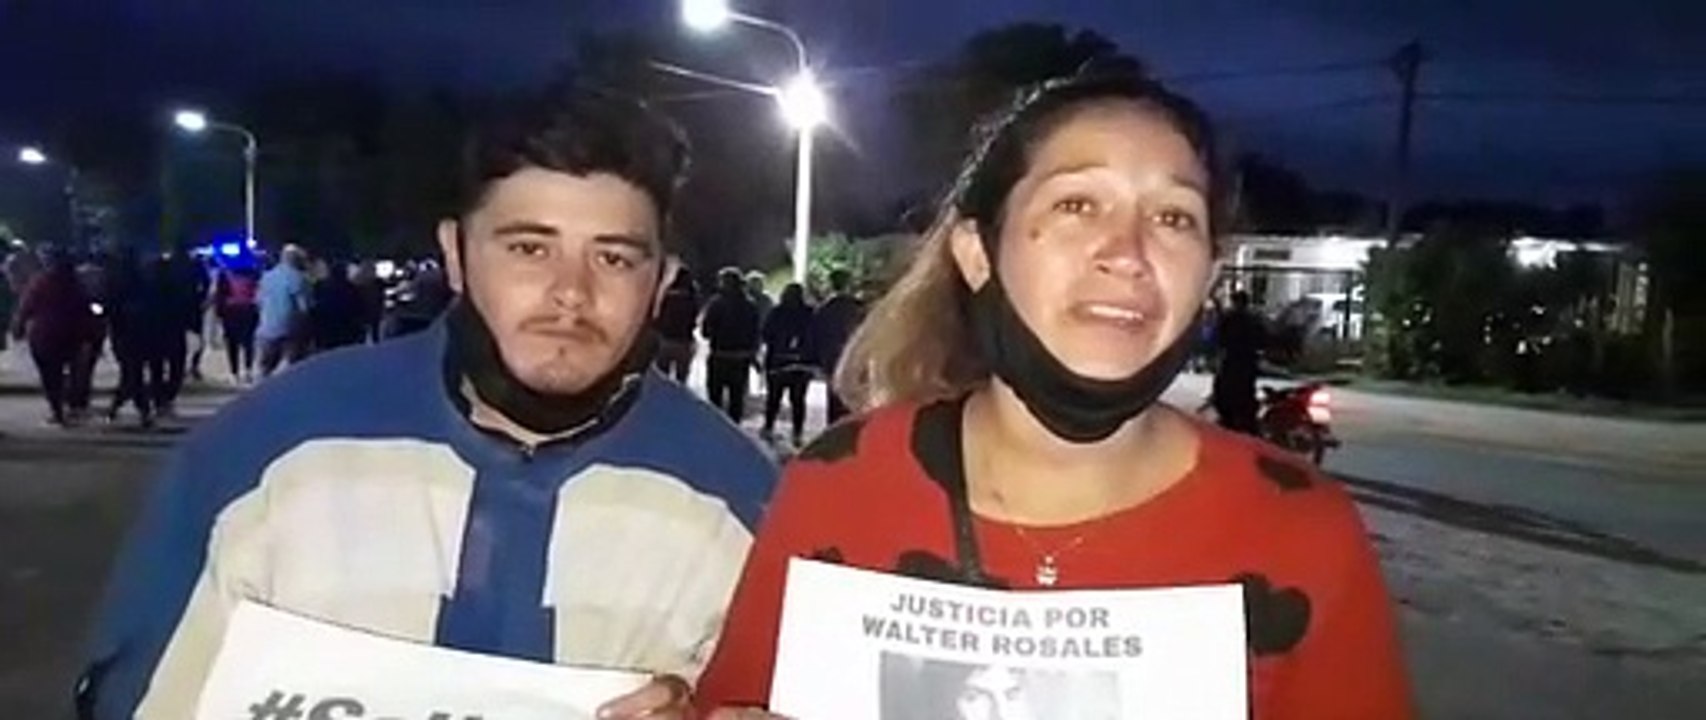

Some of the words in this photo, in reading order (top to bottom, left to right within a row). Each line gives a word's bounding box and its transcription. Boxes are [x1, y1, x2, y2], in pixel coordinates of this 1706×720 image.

[891, 593, 1032, 628] JUSTICIA
[1045, 607, 1110, 629] POR
[862, 614, 980, 652] WALTER
[991, 635, 1143, 658] ROSALES
